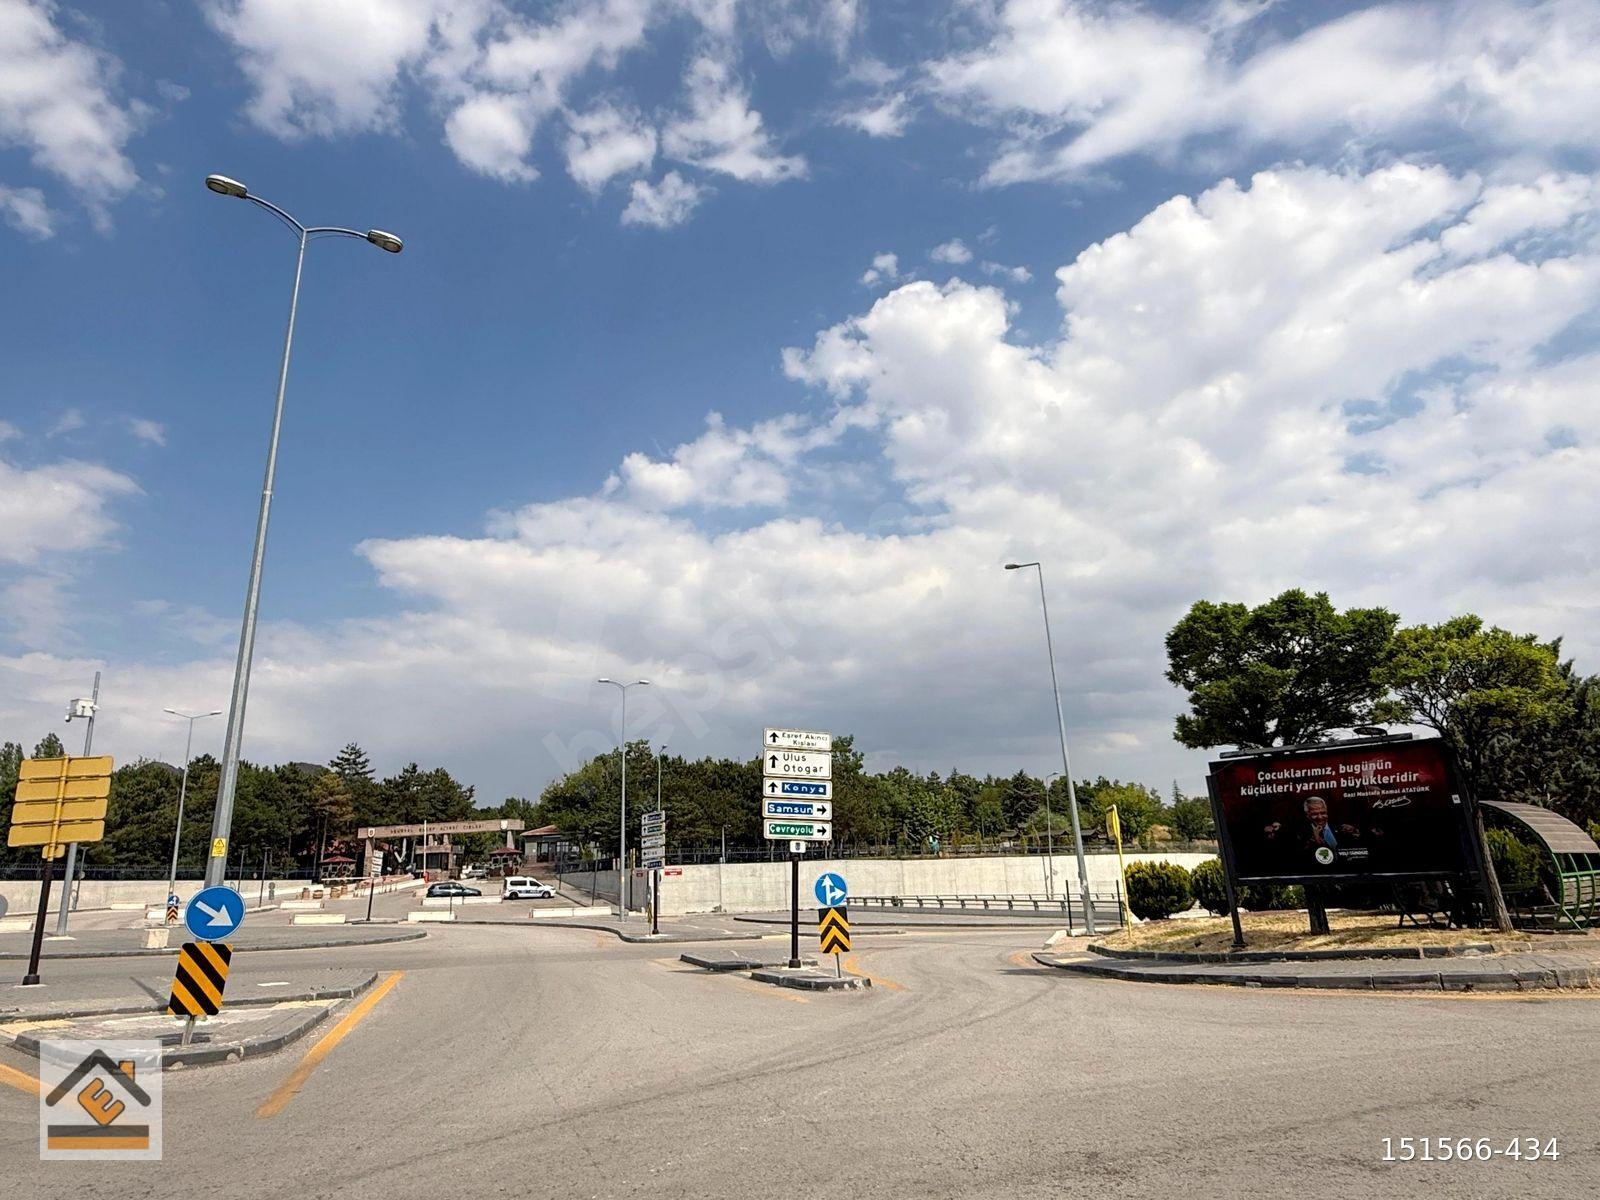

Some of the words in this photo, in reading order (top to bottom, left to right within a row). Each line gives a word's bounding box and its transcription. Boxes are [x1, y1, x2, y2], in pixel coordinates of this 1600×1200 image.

[783, 753, 807, 762] Ulus
[783, 764, 823, 774] Otogar
[1257, 766, 1336, 783] Çocuklarımız,
[1339, 760, 1392, 774] bugünün
[783, 783, 825, 794] Konya
[1240, 782, 1293, 797] küçükleri
[1295, 780, 1337, 794] yarının
[1340, 771, 1419, 789] büyükleridir
[1401, 785, 1430, 794] ATATÜRK
[768, 803, 814, 814] Samsun
[769, 824, 814, 835] Çevreyolu
